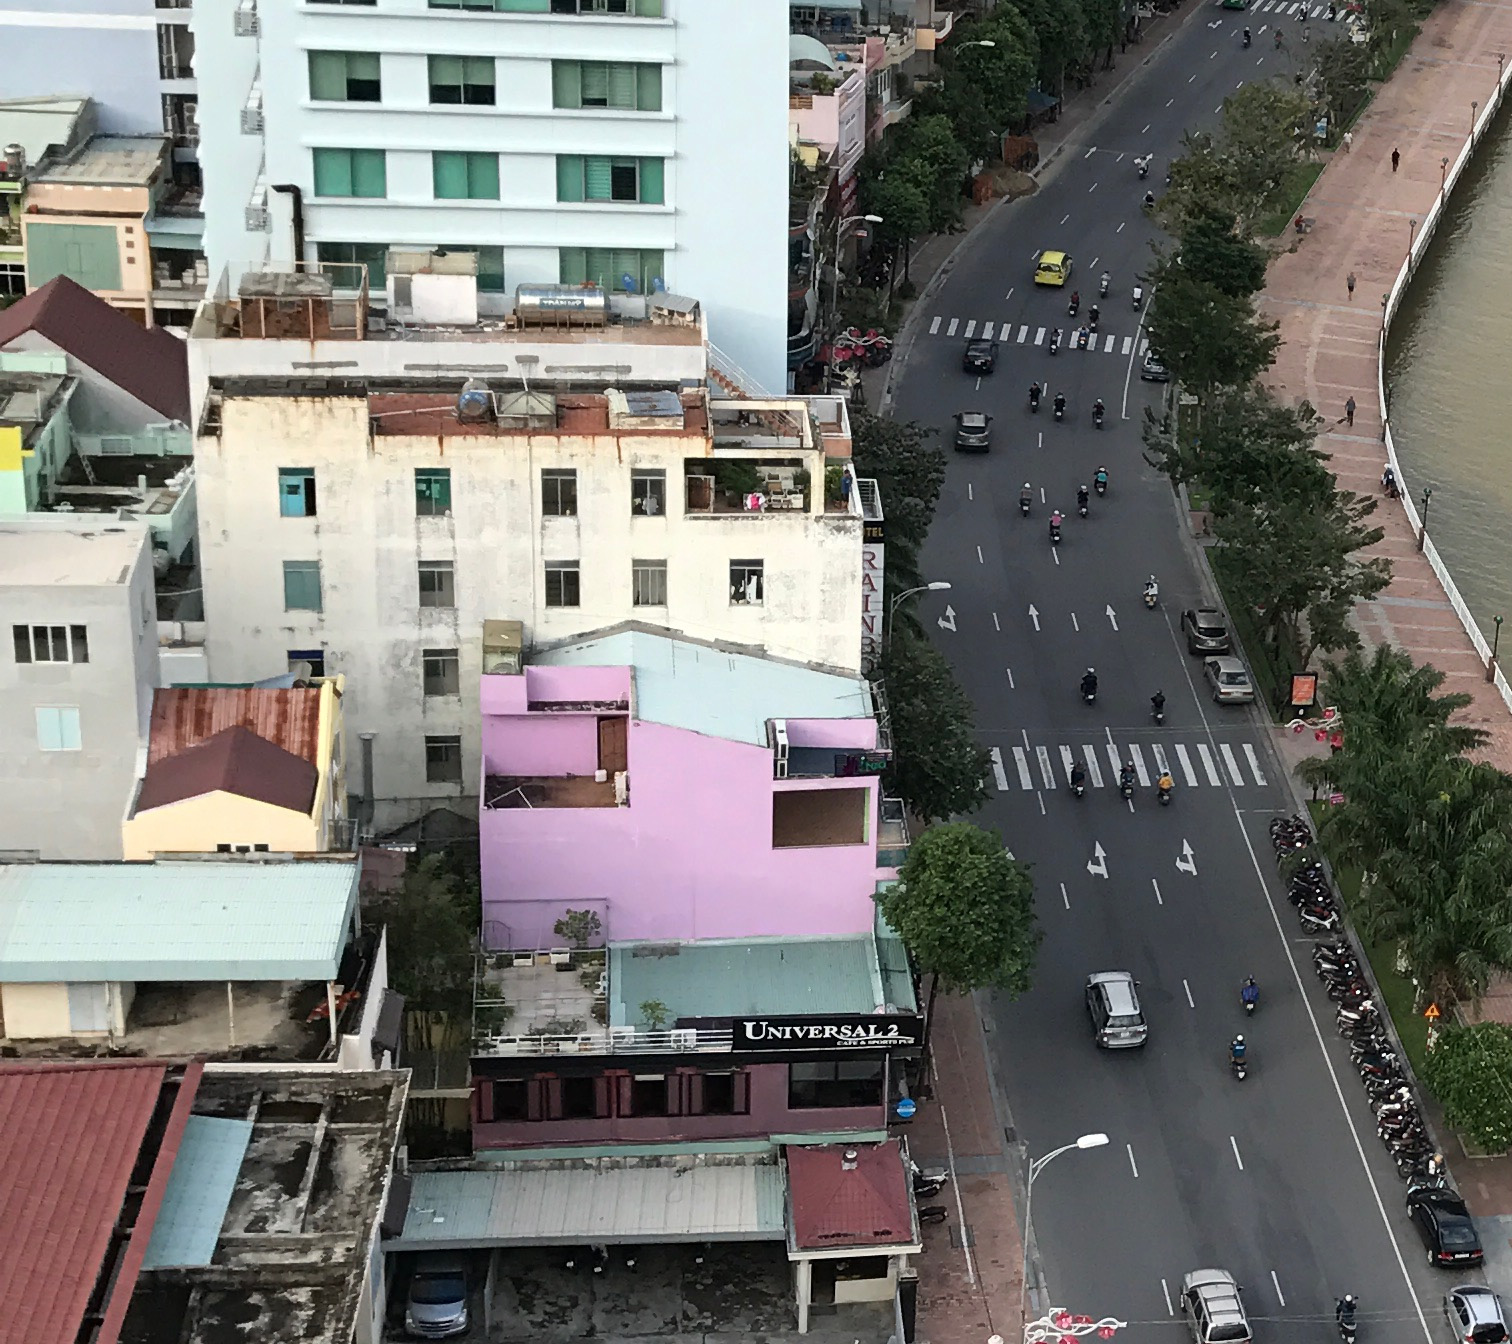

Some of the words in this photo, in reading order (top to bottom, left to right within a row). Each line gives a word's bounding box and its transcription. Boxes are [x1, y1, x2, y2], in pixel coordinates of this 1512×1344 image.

[863, 527, 884, 537] TEL
[743, 1021, 883, 1040] UNIVERSAL
[887, 1024, 899, 1037] 2
